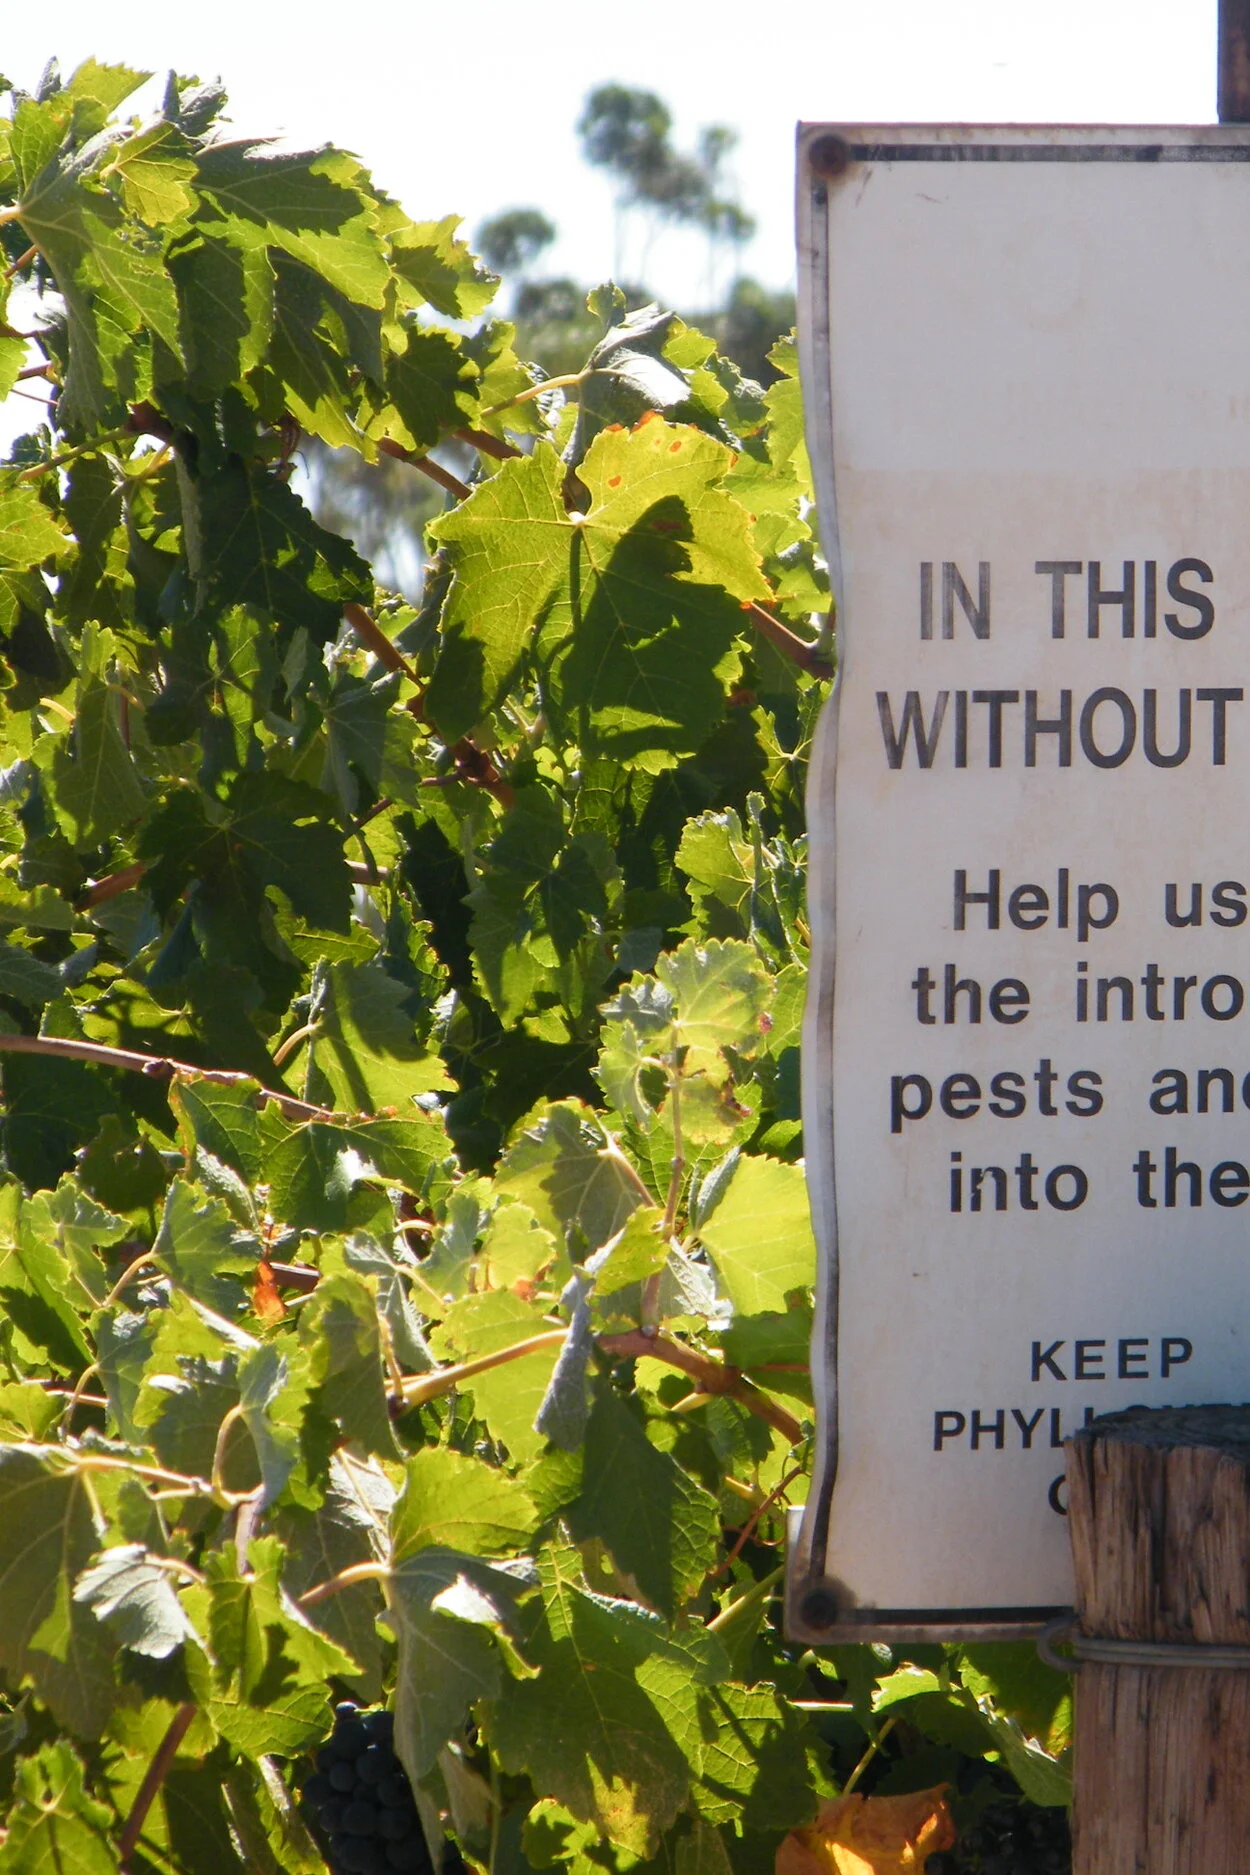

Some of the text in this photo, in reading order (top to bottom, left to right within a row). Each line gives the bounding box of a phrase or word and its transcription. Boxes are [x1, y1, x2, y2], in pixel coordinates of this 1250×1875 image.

[921, 561, 990, 640] IN
[1035, 558, 1215, 640] THIS
[876, 687, 1244, 770] WITHOUT
[954, 868, 1119, 942] Help
[1165, 881, 1248, 928] us
[911, 963, 1030, 1025] the
[891, 1059, 1104, 1134] pests
[950, 1151, 1088, 1212] into
[1132, 1146, 1250, 1208] the
[1031, 1337, 1192, 1382] KEEP
